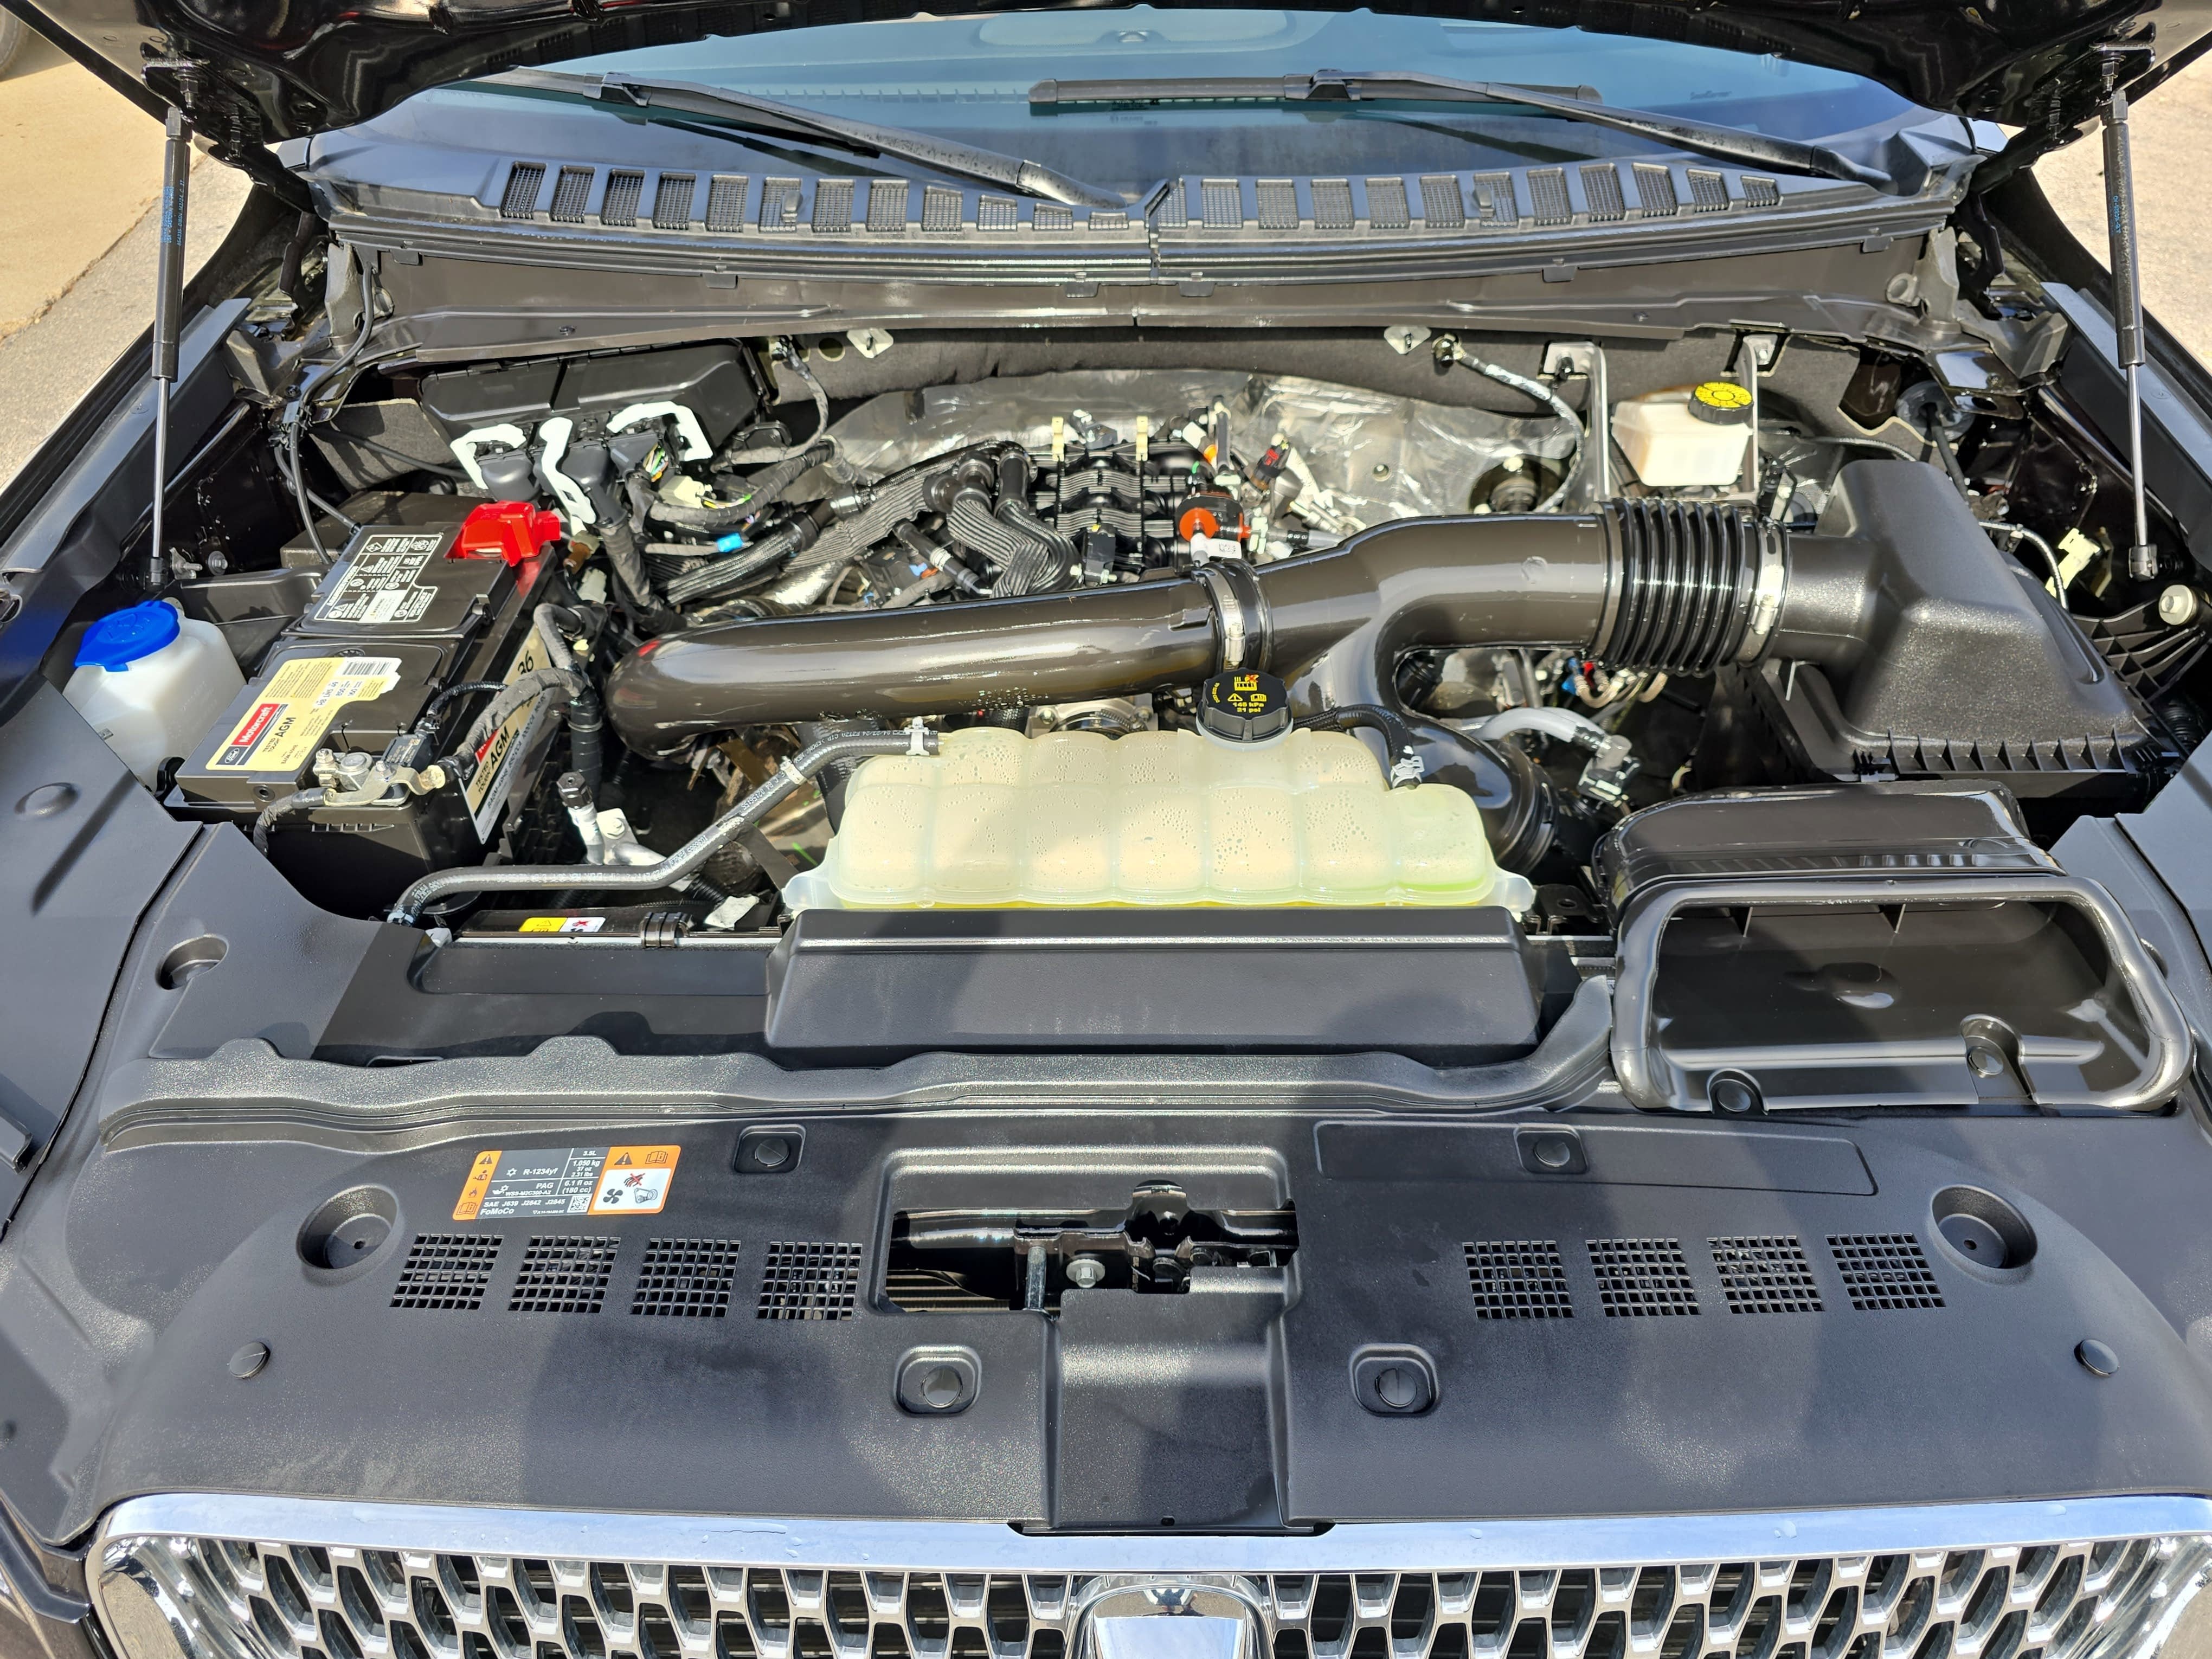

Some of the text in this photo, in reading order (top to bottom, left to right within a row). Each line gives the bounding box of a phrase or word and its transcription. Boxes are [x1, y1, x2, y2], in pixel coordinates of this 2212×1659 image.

[238, 706, 273, 743] Motorcraft
[274, 717, 297, 737] AGM
[262, 738, 275, 752] TESTED
[490, 726, 510, 768] AGM
[523, 1167, 558, 1175] R-1234yf
[480, 1207, 515, 1216] FoMoCo
